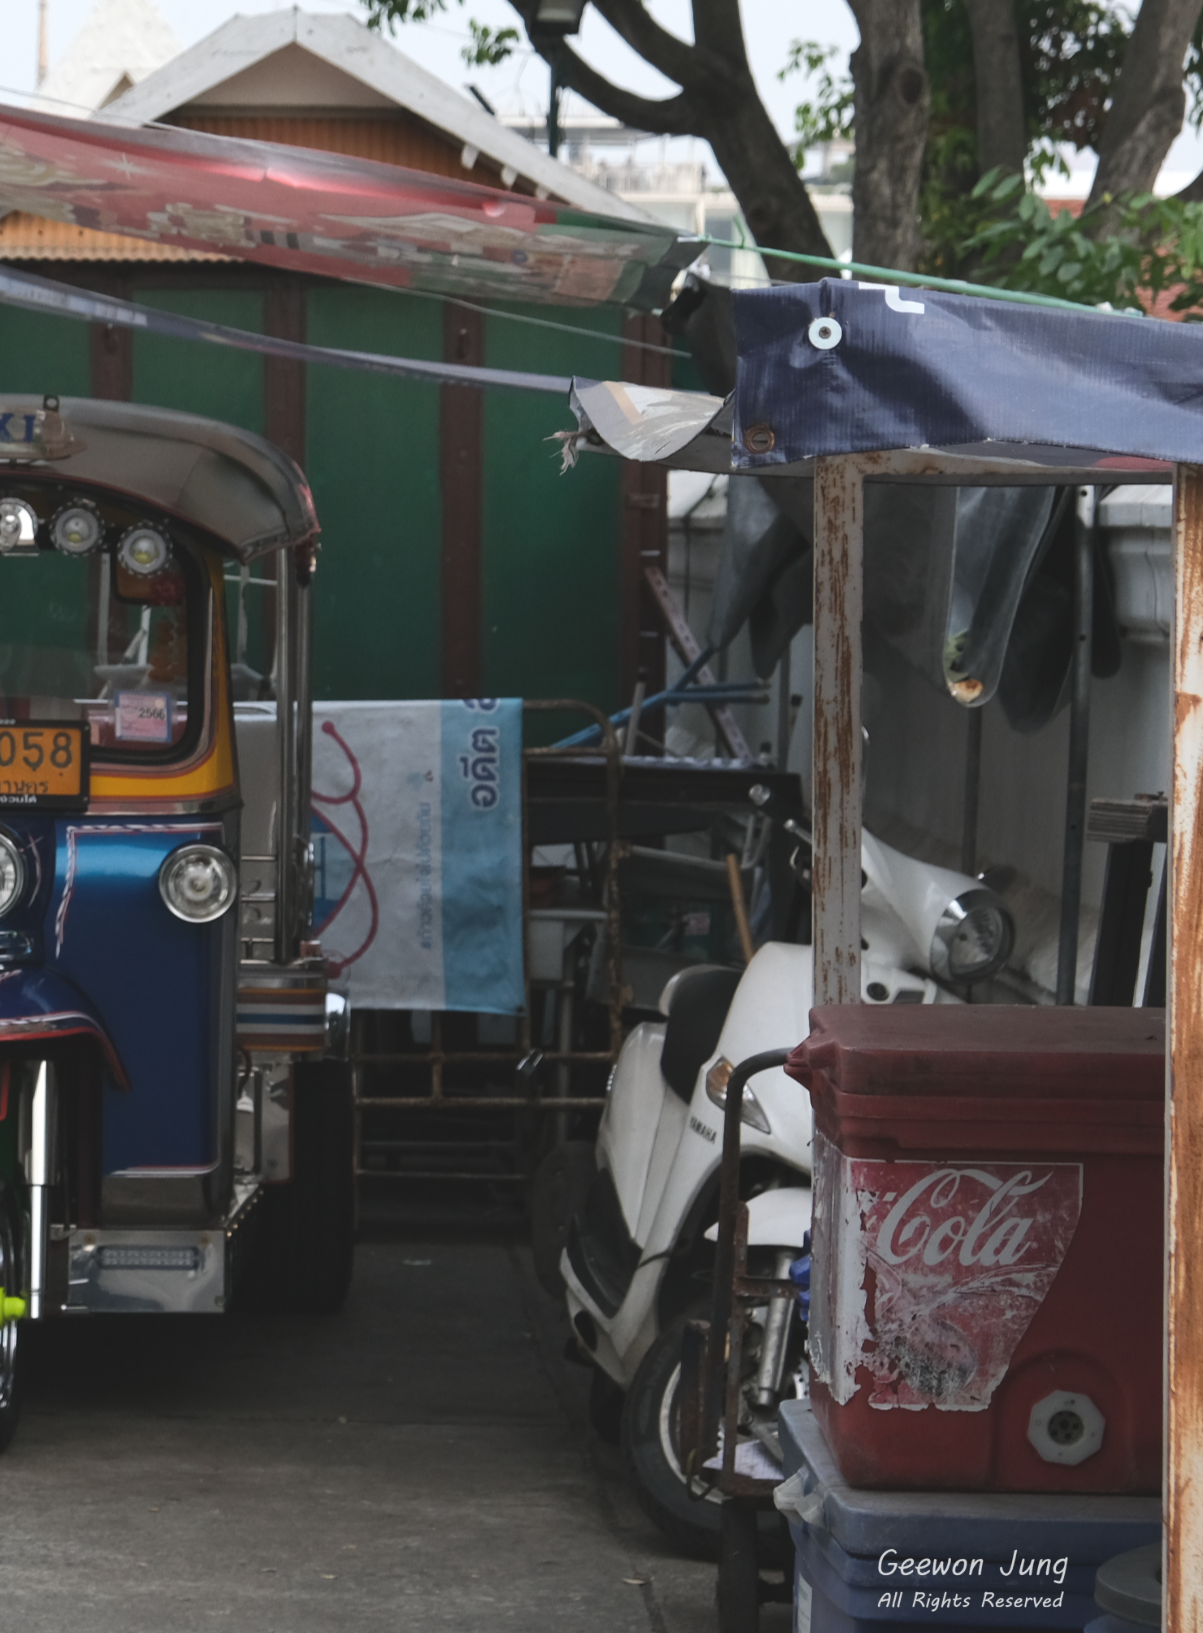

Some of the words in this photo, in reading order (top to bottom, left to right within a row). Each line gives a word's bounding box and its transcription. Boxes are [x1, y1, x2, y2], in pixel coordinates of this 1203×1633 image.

[139, 707, 165, 720] 2566
[459, 728, 497, 807] อดีต
[689, 1116, 718, 1145] YAMAHA
